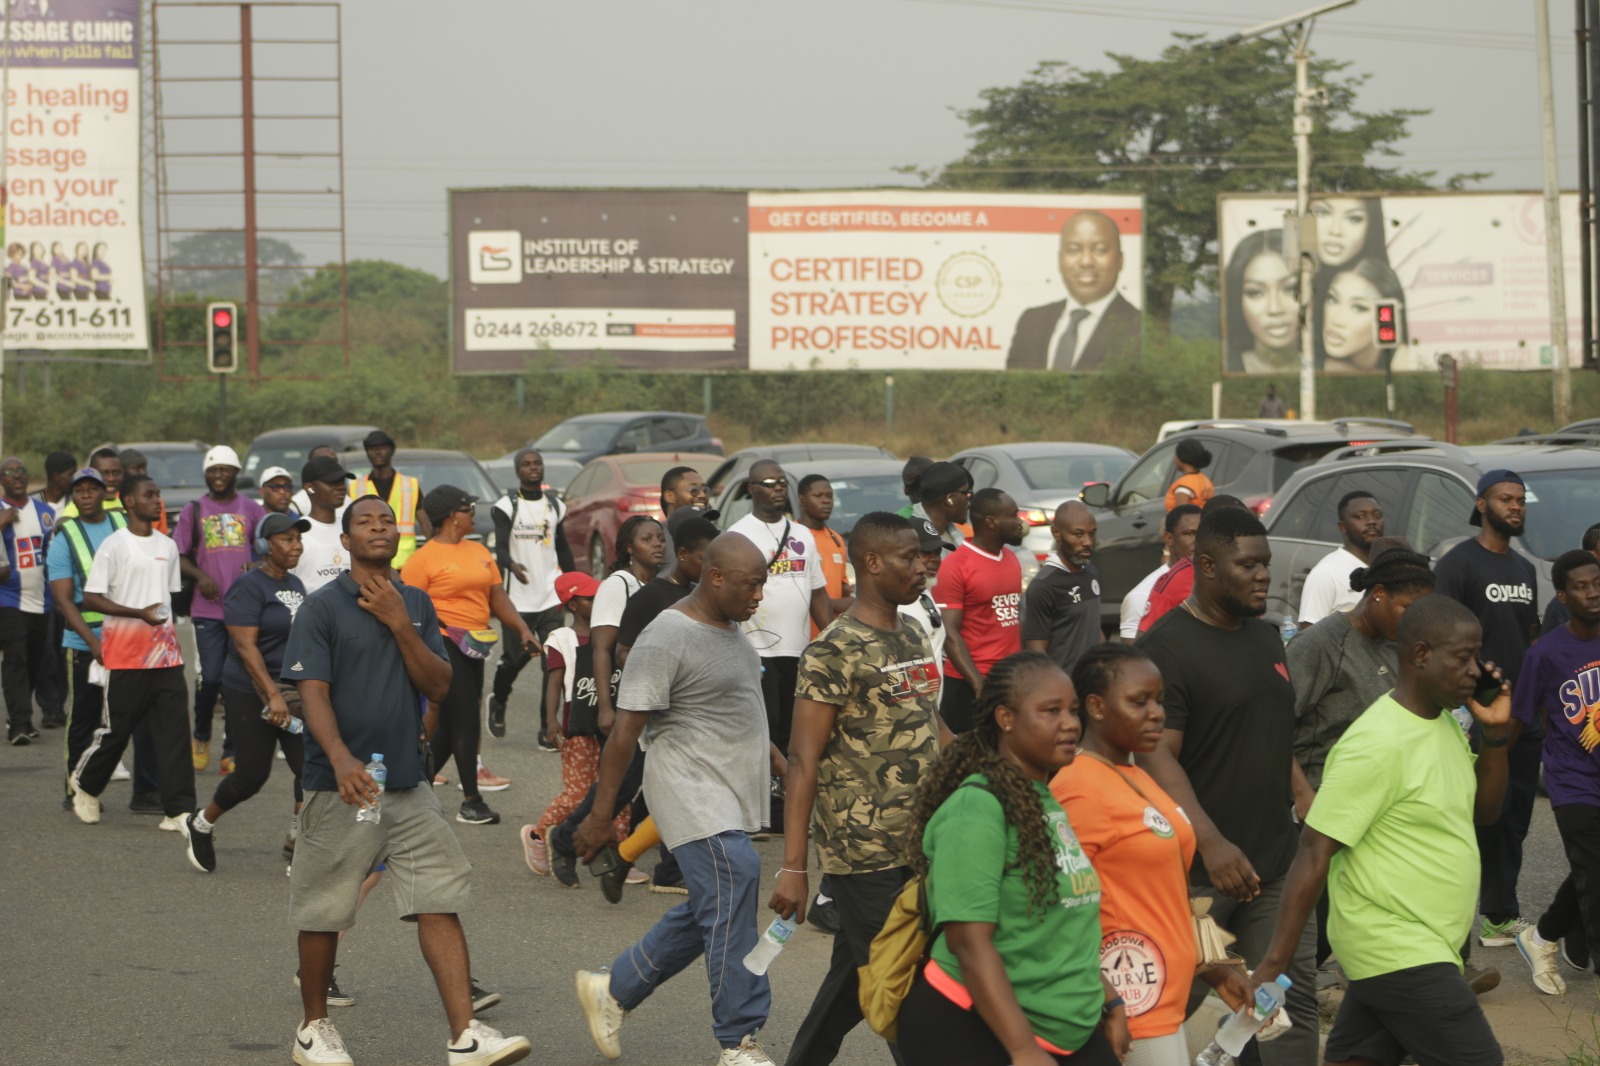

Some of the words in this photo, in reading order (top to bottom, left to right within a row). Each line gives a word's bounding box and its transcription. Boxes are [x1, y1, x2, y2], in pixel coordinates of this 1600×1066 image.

[72, 20, 134, 43] CLINIC
[14, 43, 60, 58] when
[62, 43, 102, 61] pills
[104, 43, 134, 59] fail
[26, 82, 129, 113] healing
[52, 112, 81, 136] of
[53, 177, 118, 202] your
[9, 202, 126, 226] balance.
[768, 210, 801, 226] GET
[805, 211, 897, 228] CERTIFIED,
[901, 211, 972, 226] BECOME
[975, 212, 988, 226] A
[524, 239, 610, 255] INSTITUTE
[613, 239, 639, 255] OF
[525, 257, 630, 273] LEADERSHIP
[633, 258, 646, 273] &
[648, 258, 734, 274] STRATEGY
[769, 257, 923, 282] CERTIFIED
[769, 292, 928, 316] STRATEGY
[9, 307, 131, 328] 7-611-611
[473, 321, 523, 338] 0244
[528, 321, 598, 338] 268672
[770, 326, 1002, 351] PROFESSIONAL
[991, 592, 1021, 609] SEVEN
